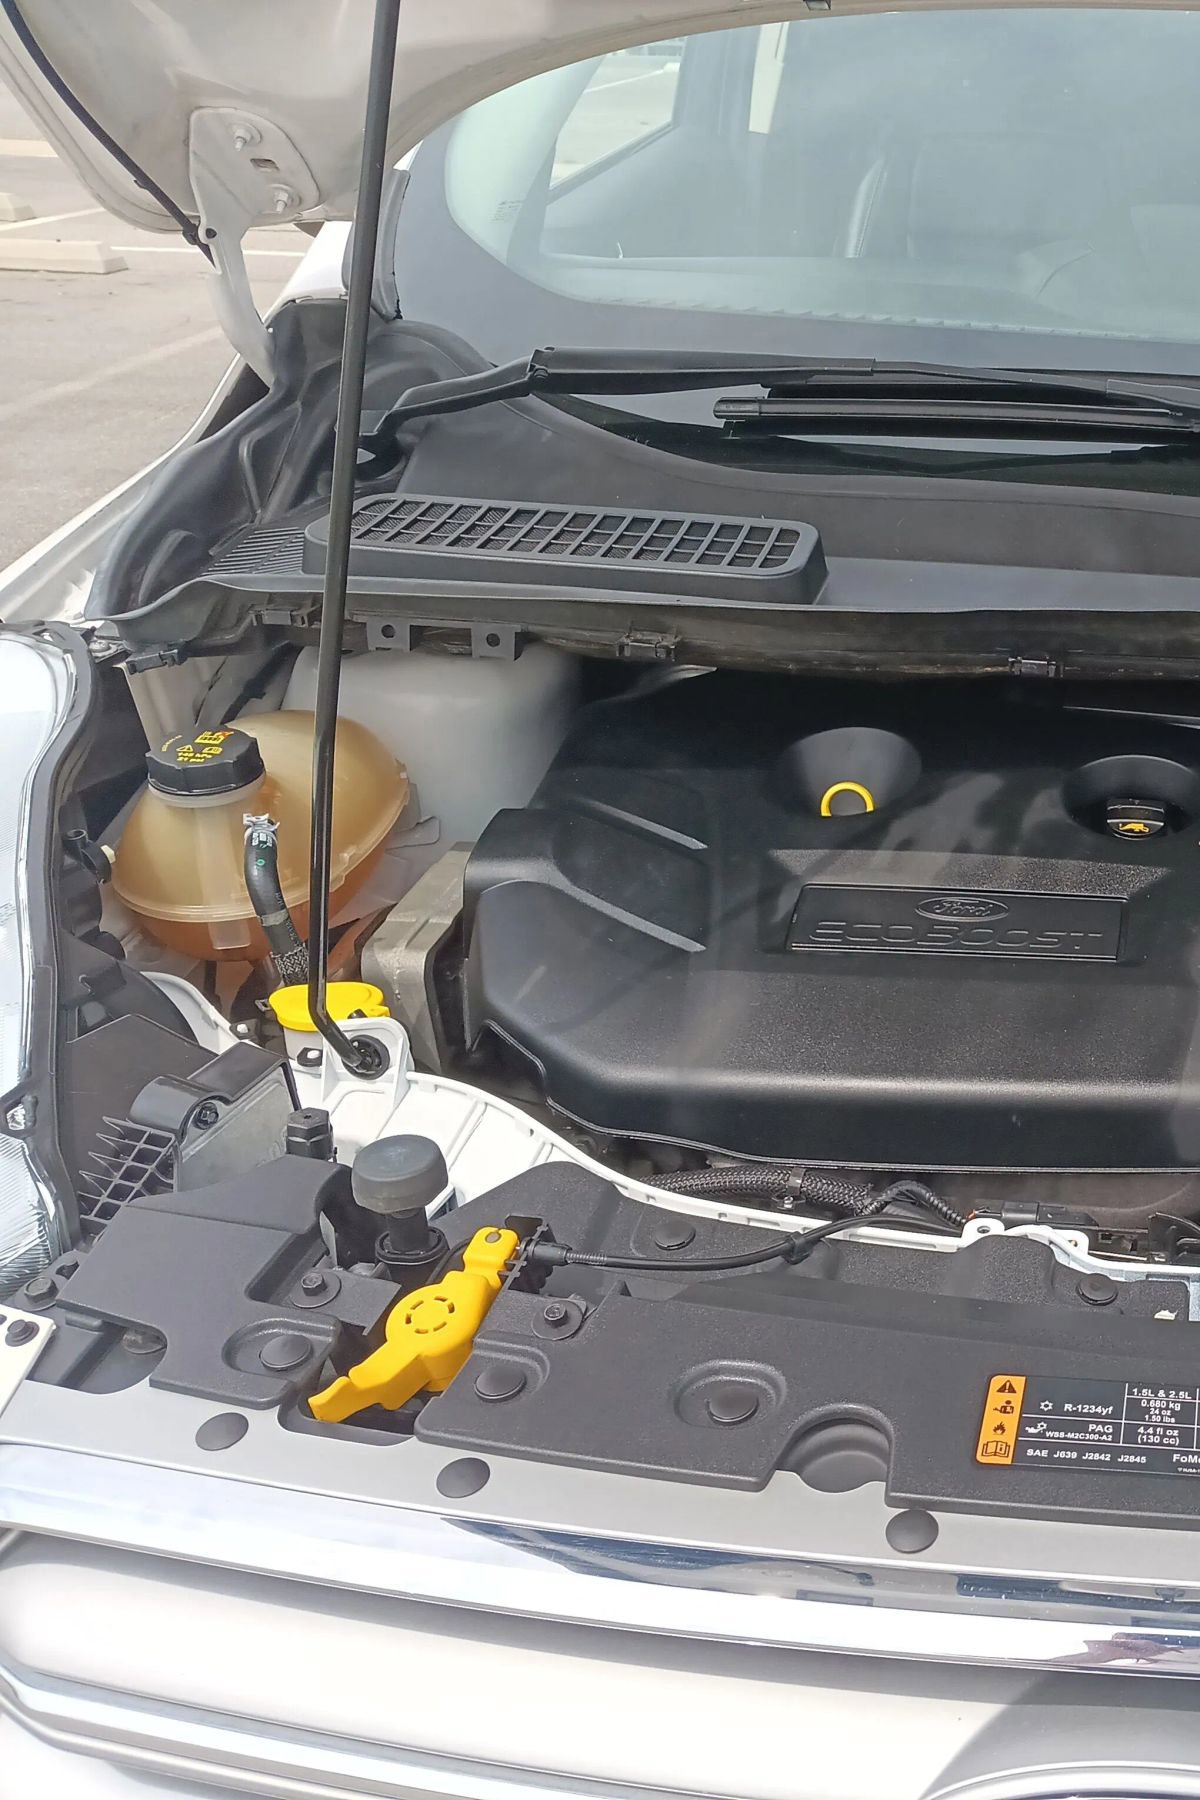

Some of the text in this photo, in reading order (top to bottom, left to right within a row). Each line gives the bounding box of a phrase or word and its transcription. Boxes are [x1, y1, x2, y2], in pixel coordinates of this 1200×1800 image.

[933, 897, 994, 917] Ford
[809, 921, 1104, 950] ECOBOOST
[1132, 1388, 1192, 1400] 1.5L & 2.5L
[1064, 1403, 1113, 1415] R-1234yf
[1141, 1399, 1181, 1412] 0.680 kg
[1162, 1415, 1176, 1423] lbs
[1088, 1424, 1113, 1433] PAG
[1137, 1426, 1179, 1437] 4.4 fl oz
[1046, 1431, 1113, 1441] WSS-M2C300-A2
[1137, 1434, 1180, 1446] (130 cc)
[1026, 1449, 1147, 1464] SAE J639 J2842 J2845
